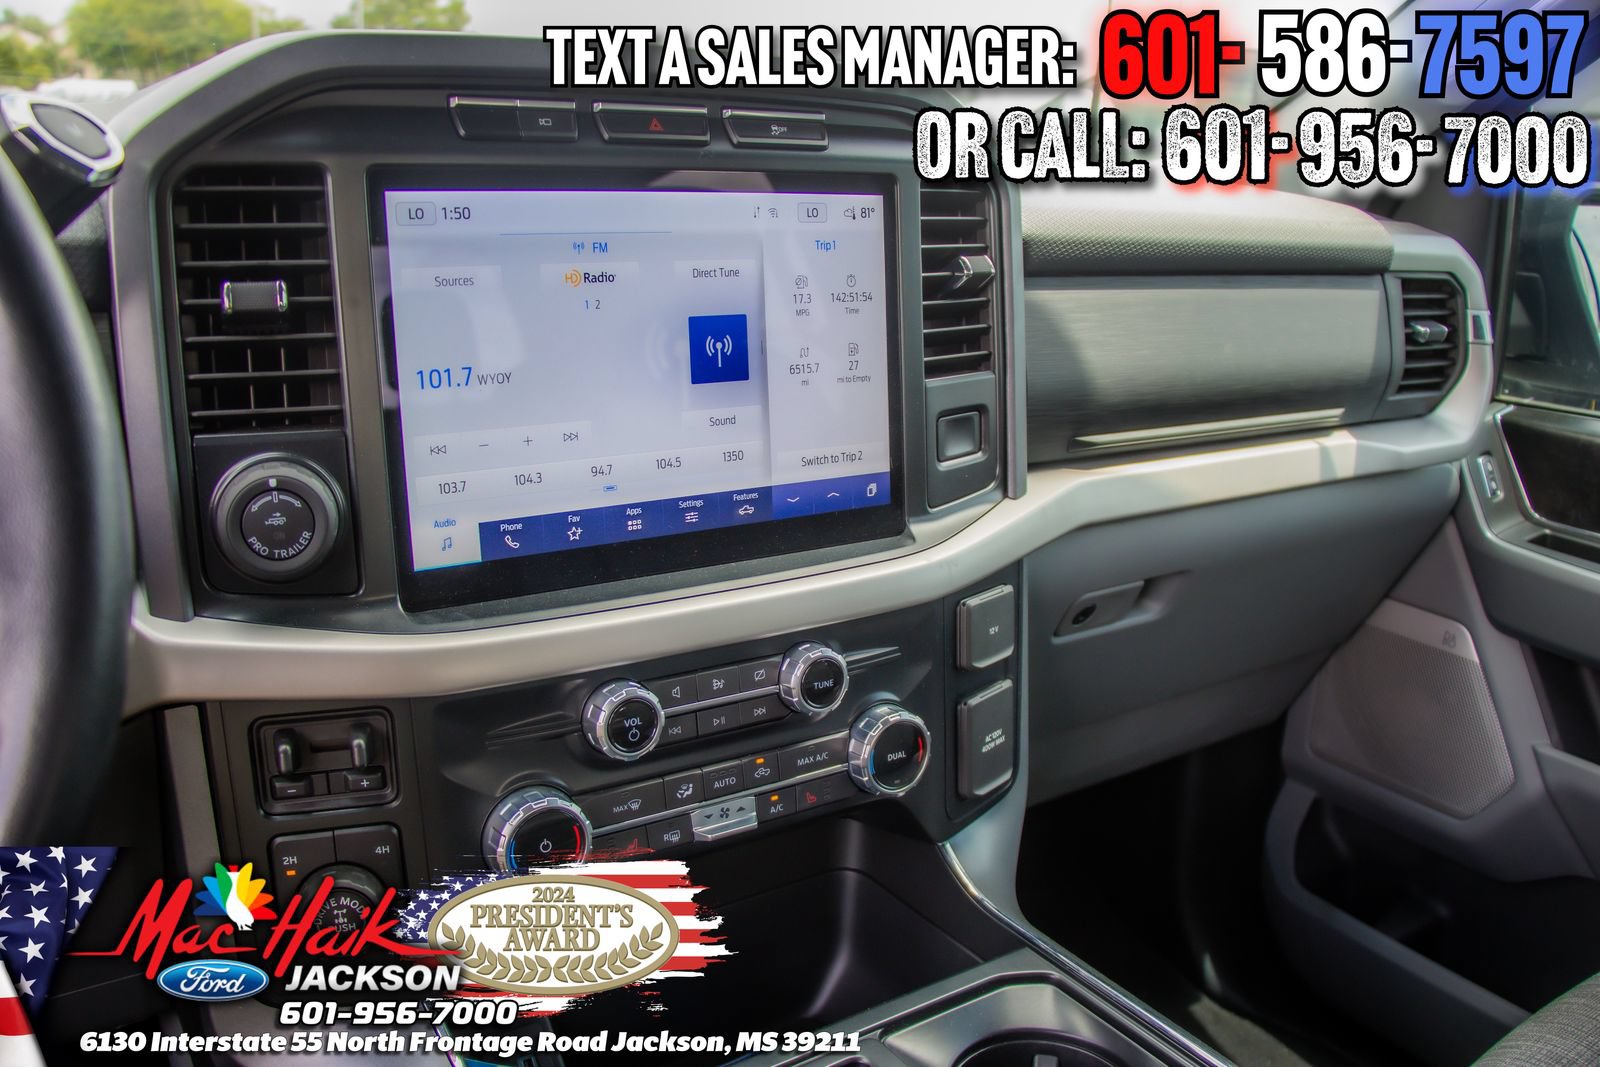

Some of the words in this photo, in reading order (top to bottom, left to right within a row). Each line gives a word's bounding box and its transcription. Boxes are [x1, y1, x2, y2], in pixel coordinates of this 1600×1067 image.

[408, 207, 424, 220] LO
[441, 206, 471, 221] 1:50
[806, 207, 819, 218] LO
[592, 242, 608, 253] FM
[583, 271, 616, 284] Radio
[692, 268, 717, 278] Direct
[719, 268, 740, 278] Tune
[434, 275, 474, 288] Sources
[793, 294, 812, 304] 17.3
[831, 292, 873, 303] 142:51:54
[796, 309, 810, 317] MPG
[789, 363, 820, 375] 6515.7
[848, 361, 859, 371] 27
[416, 367, 473, 390] 101.7
[477, 372, 512, 386] WYOY
[852, 374, 871, 384] Empty
[709, 415, 736, 427] Sound
[722, 450, 744, 462] 1350
[801, 454, 829, 467] Switch
[831, 454, 839, 463] to
[841, 452, 857, 465] Trip
[656, 457, 682, 470] 104.5
[591, 465, 613, 477] 94.7
[514, 473, 543, 486] 104.3
[438, 481, 466, 495] 103.7
[733, 492, 759, 501] Features
[678, 499, 704, 509] Settings
[626, 507, 642, 516] Apps
[433, 518, 456, 529] Audio
[568, 514, 580, 523] Fav
[500, 522, 523, 532] Phone
[247, 536, 269, 556] PRO
[273, 530, 312, 558] TRAILER
[812, 678, 835, 690] TUNE
[624, 717, 643, 727] VOL
[797, 756, 814, 766] MAX
[815, 751, 829, 762] A/C
[887, 749, 907, 762] DUAL
[714, 776, 736, 789] AUTO
[613, 803, 628, 814] MAX
[770, 803, 784, 814] A/C
[375, 845, 390, 855] 4H
[283, 856, 298, 865] 2H
